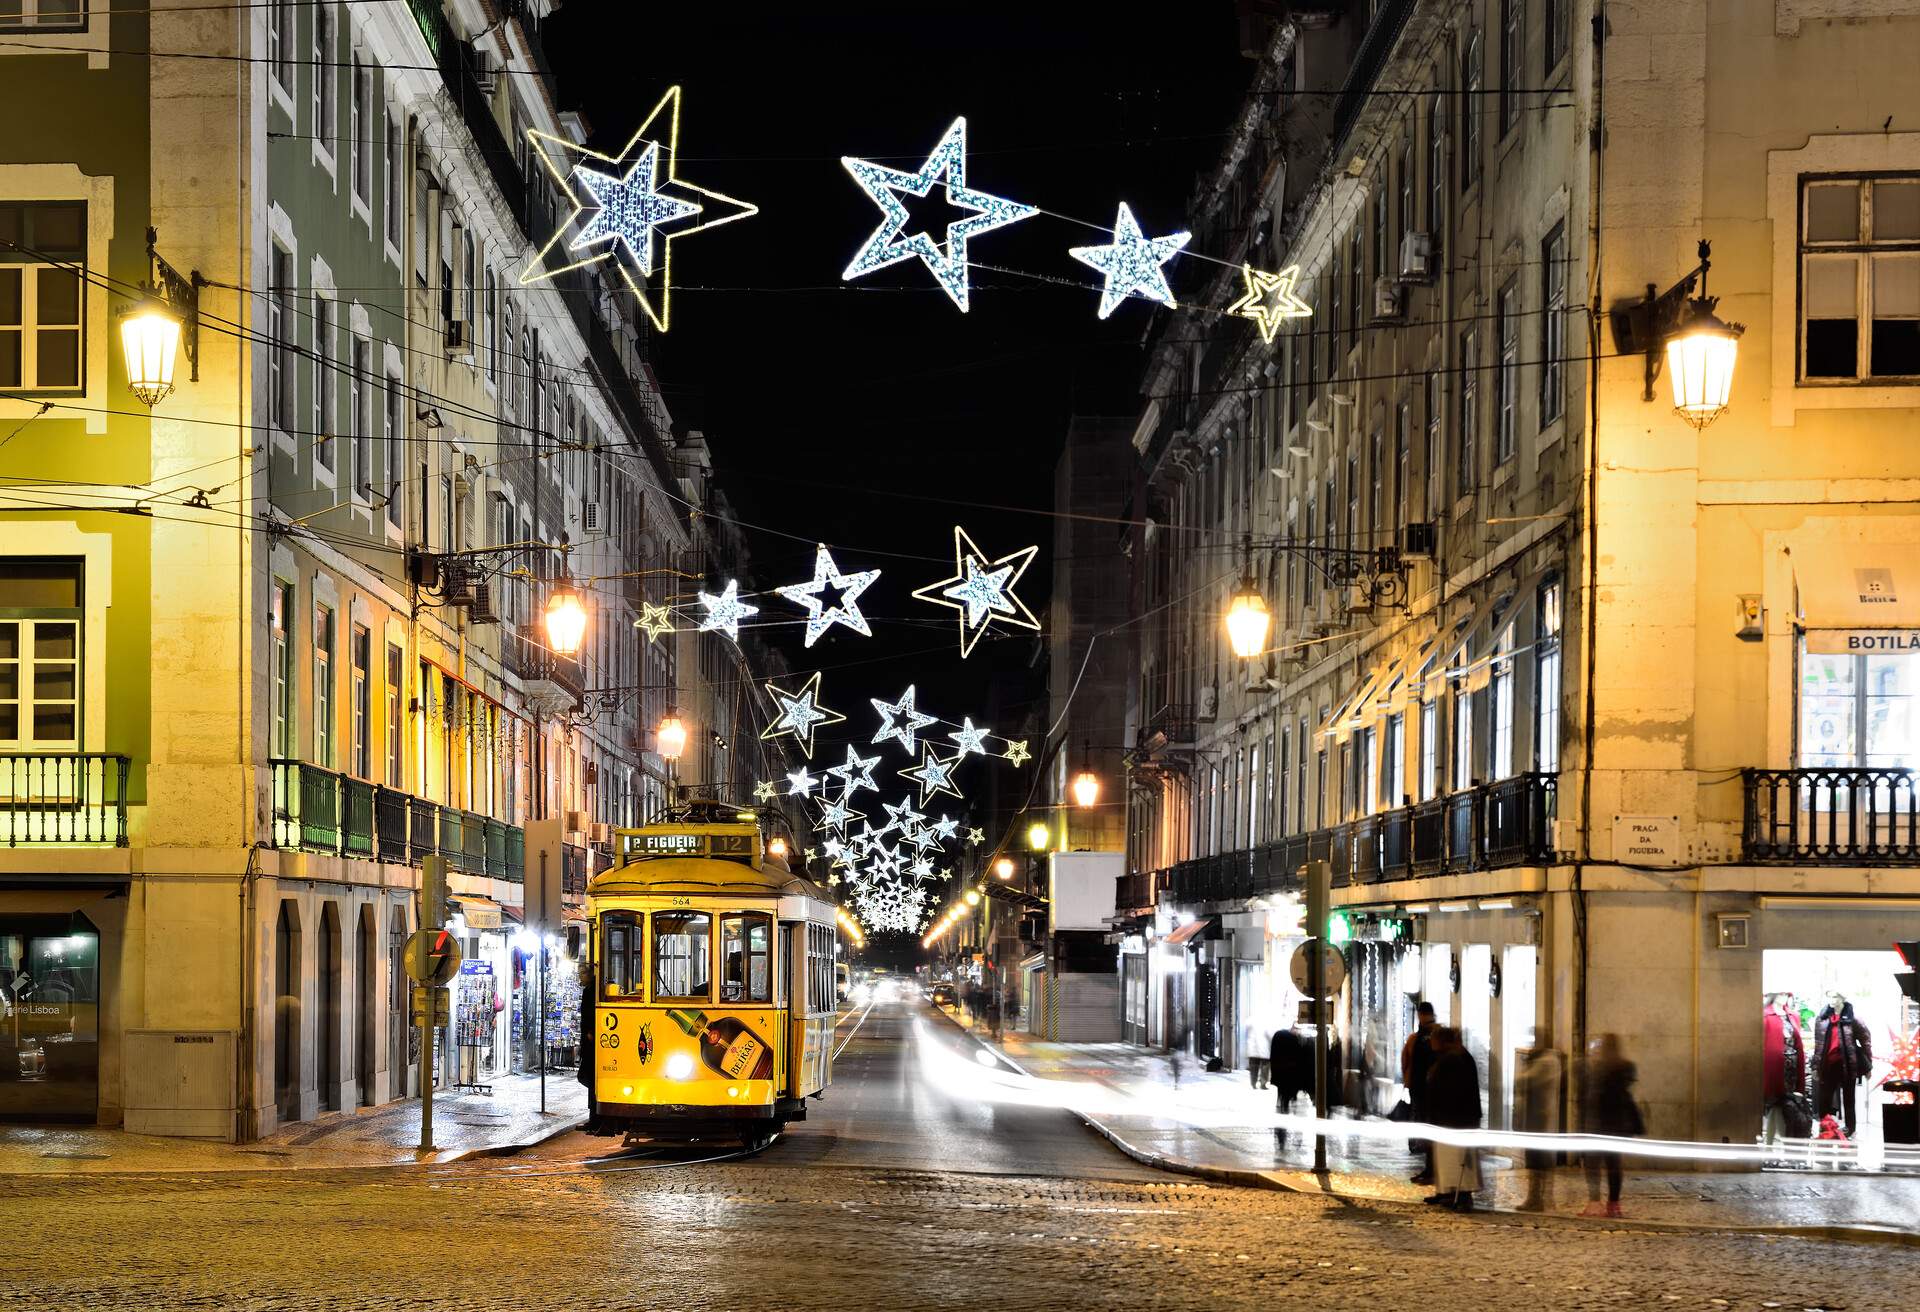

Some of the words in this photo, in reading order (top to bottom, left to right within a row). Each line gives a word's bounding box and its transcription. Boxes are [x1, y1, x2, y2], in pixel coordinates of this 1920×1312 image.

[647, 837, 704, 848] FIGUEIRA
[722, 837, 742, 850] 12
[673, 897, 689, 905] 564
[30, 1005, 60, 1014] Lisboa
[730, 1040, 755, 1075] BEIRÃO
